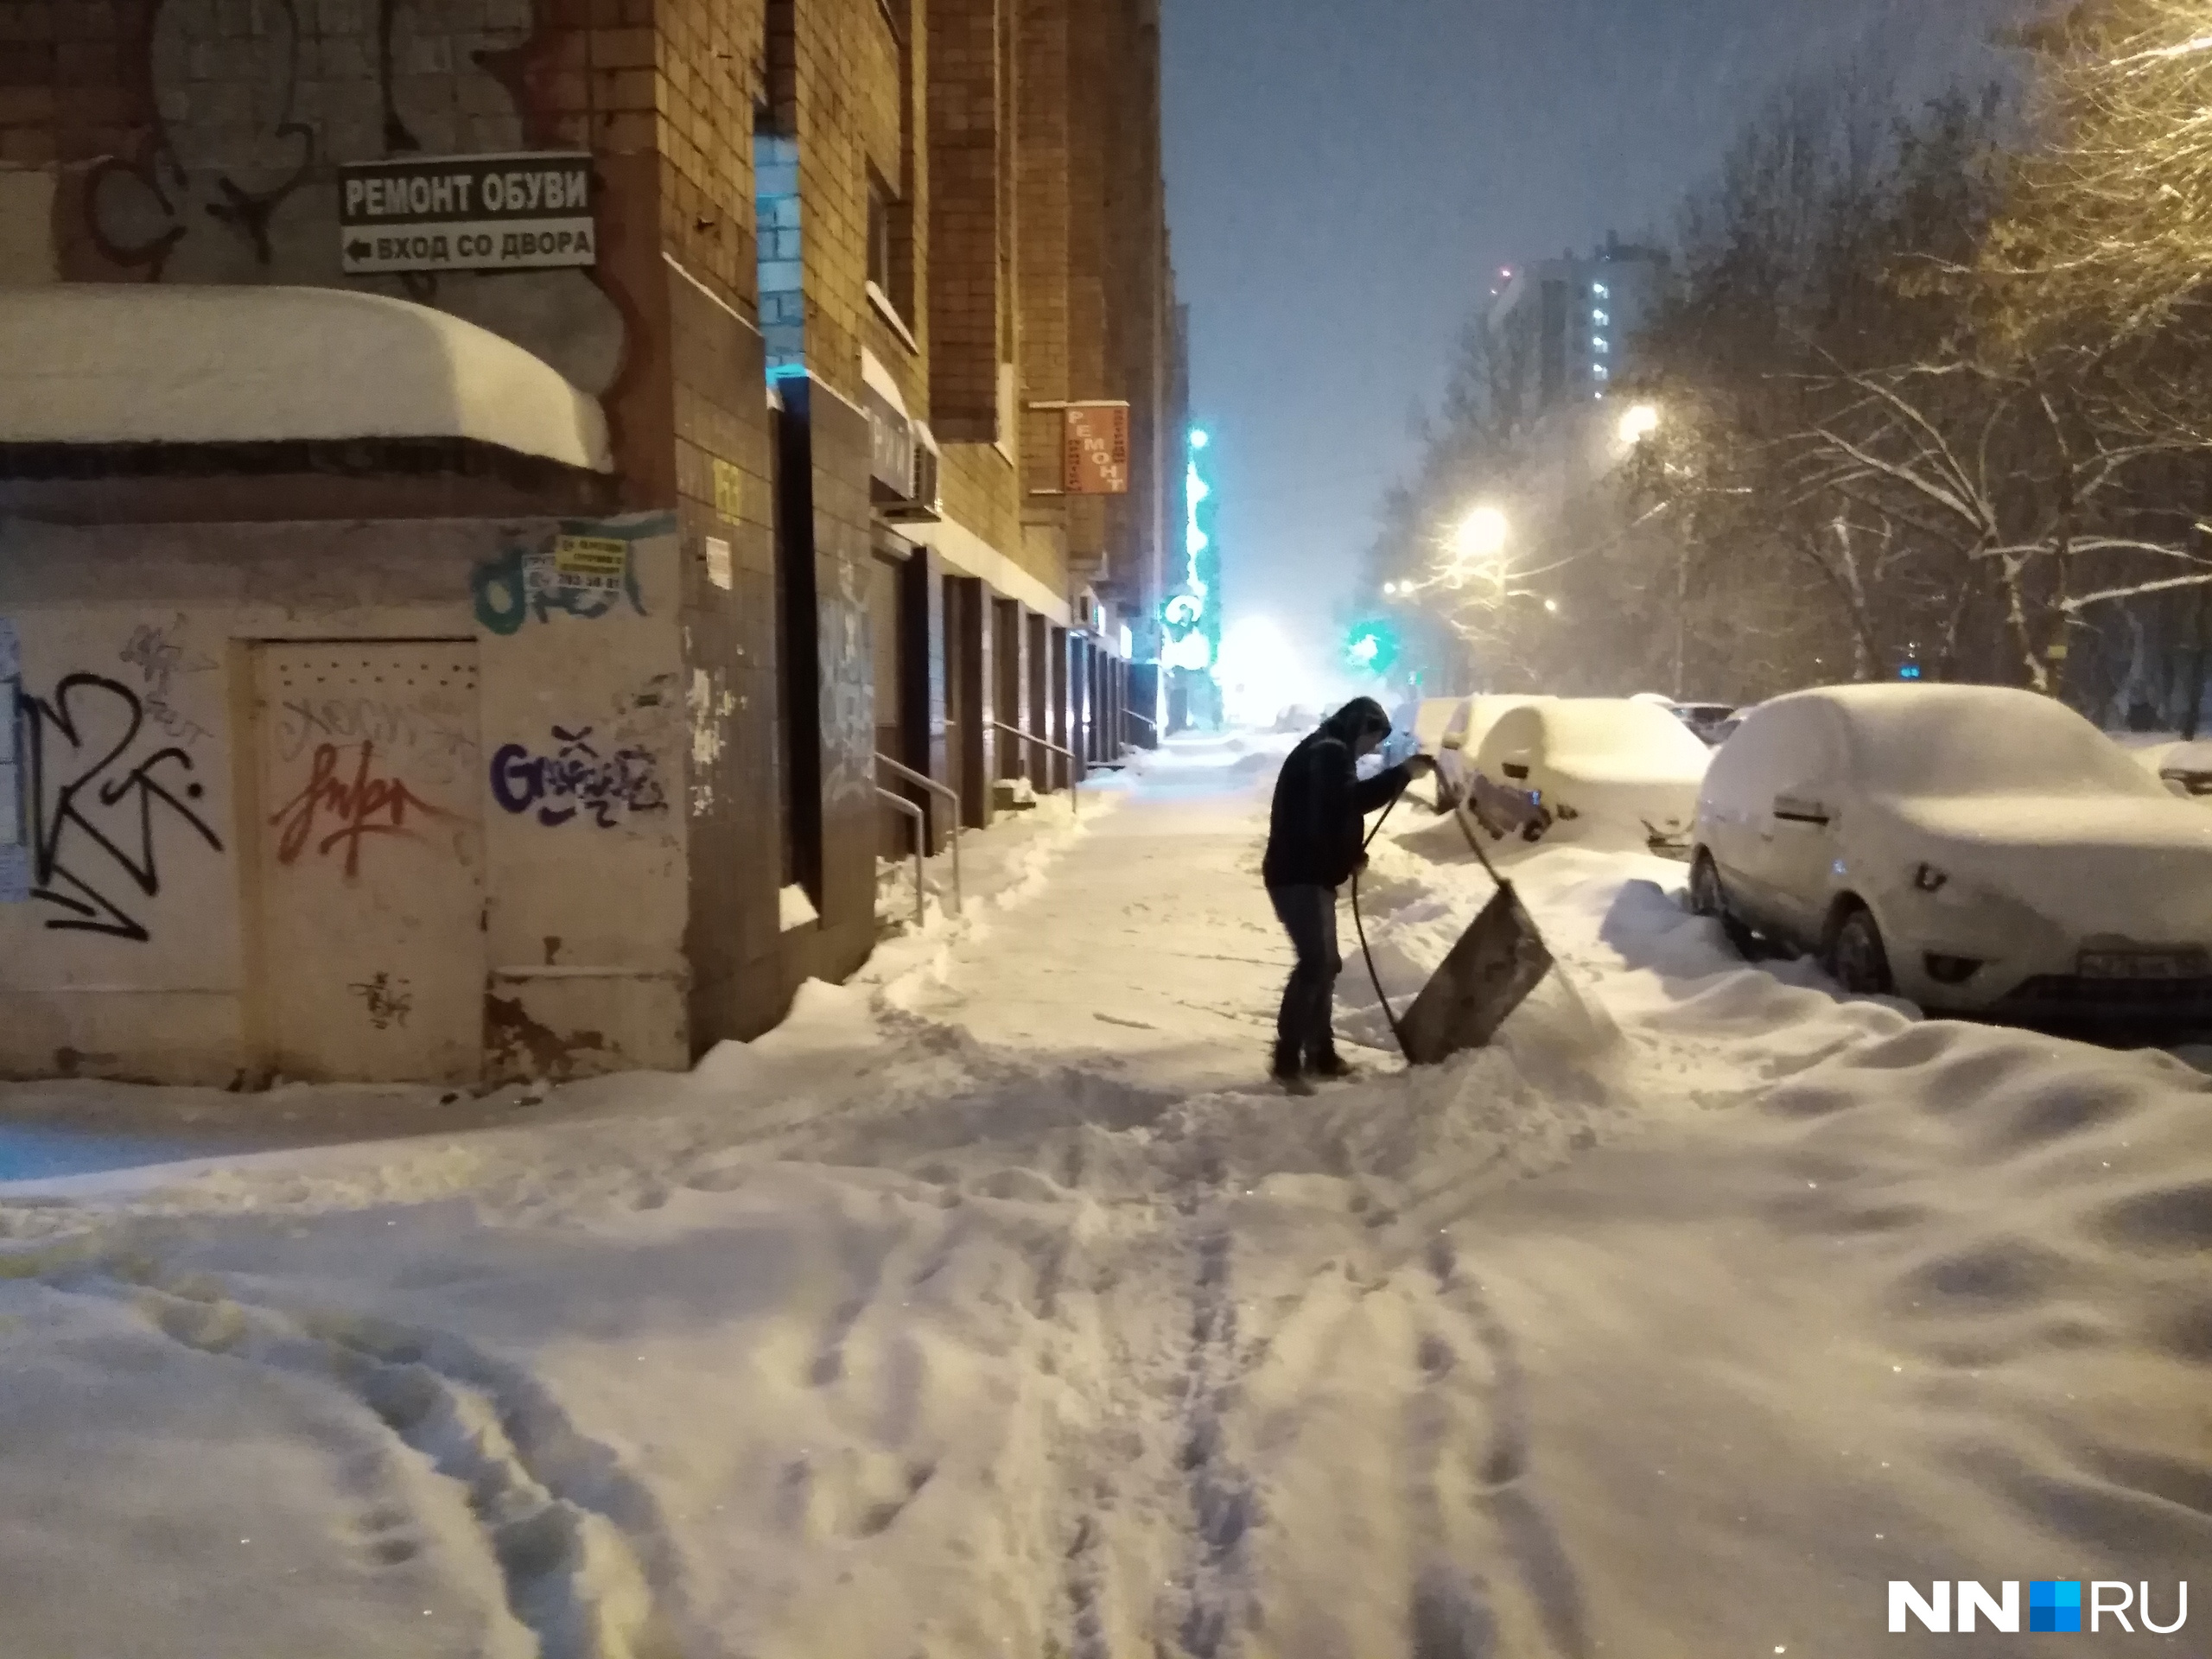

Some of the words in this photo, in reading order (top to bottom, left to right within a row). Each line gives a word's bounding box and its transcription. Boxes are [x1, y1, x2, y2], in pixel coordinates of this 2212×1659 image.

[346, 175, 472, 215] РЕМОНТ
[482, 171, 588, 211] ОБУВИ
[377, 237, 450, 261] ВХОД
[456, 234, 493, 257] СО
[501, 231, 591, 261] ДВОРА
[1068, 410, 1123, 493] РЕМОНТ
